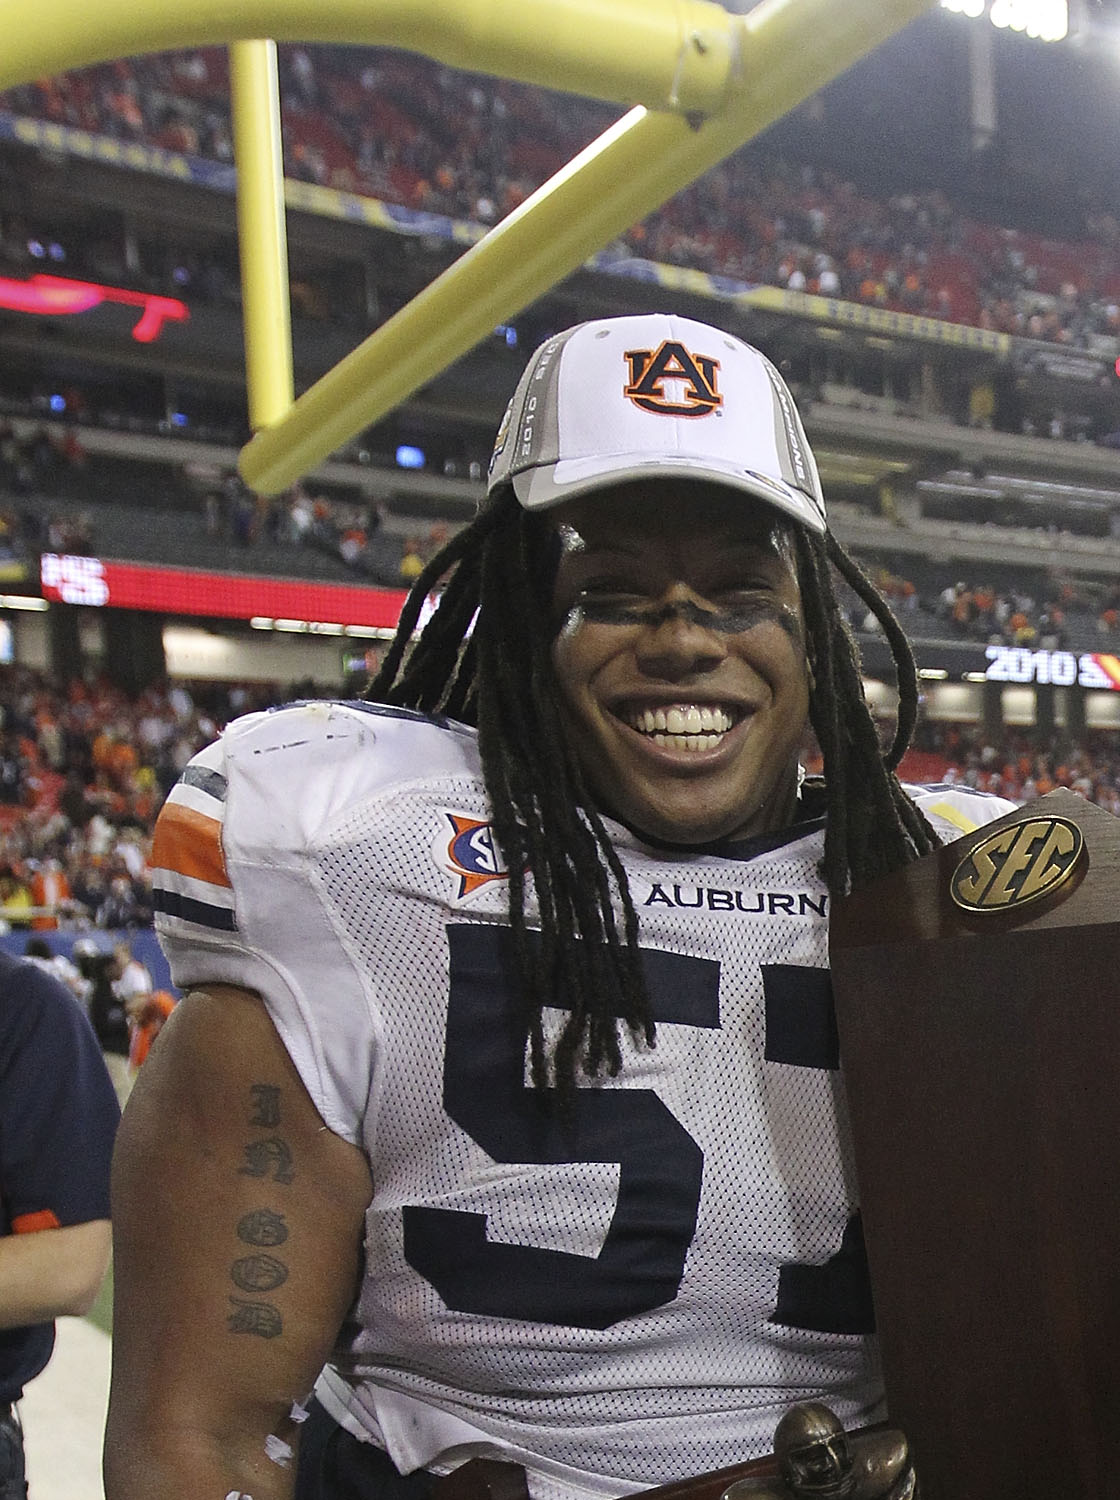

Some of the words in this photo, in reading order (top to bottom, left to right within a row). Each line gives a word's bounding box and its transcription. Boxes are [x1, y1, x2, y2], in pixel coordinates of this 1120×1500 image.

[521, 397, 538, 456] 2010
[985, 645, 1077, 686] 2010
[957, 820, 1075, 905] SEC
[643, 883, 828, 918] AUBURN
